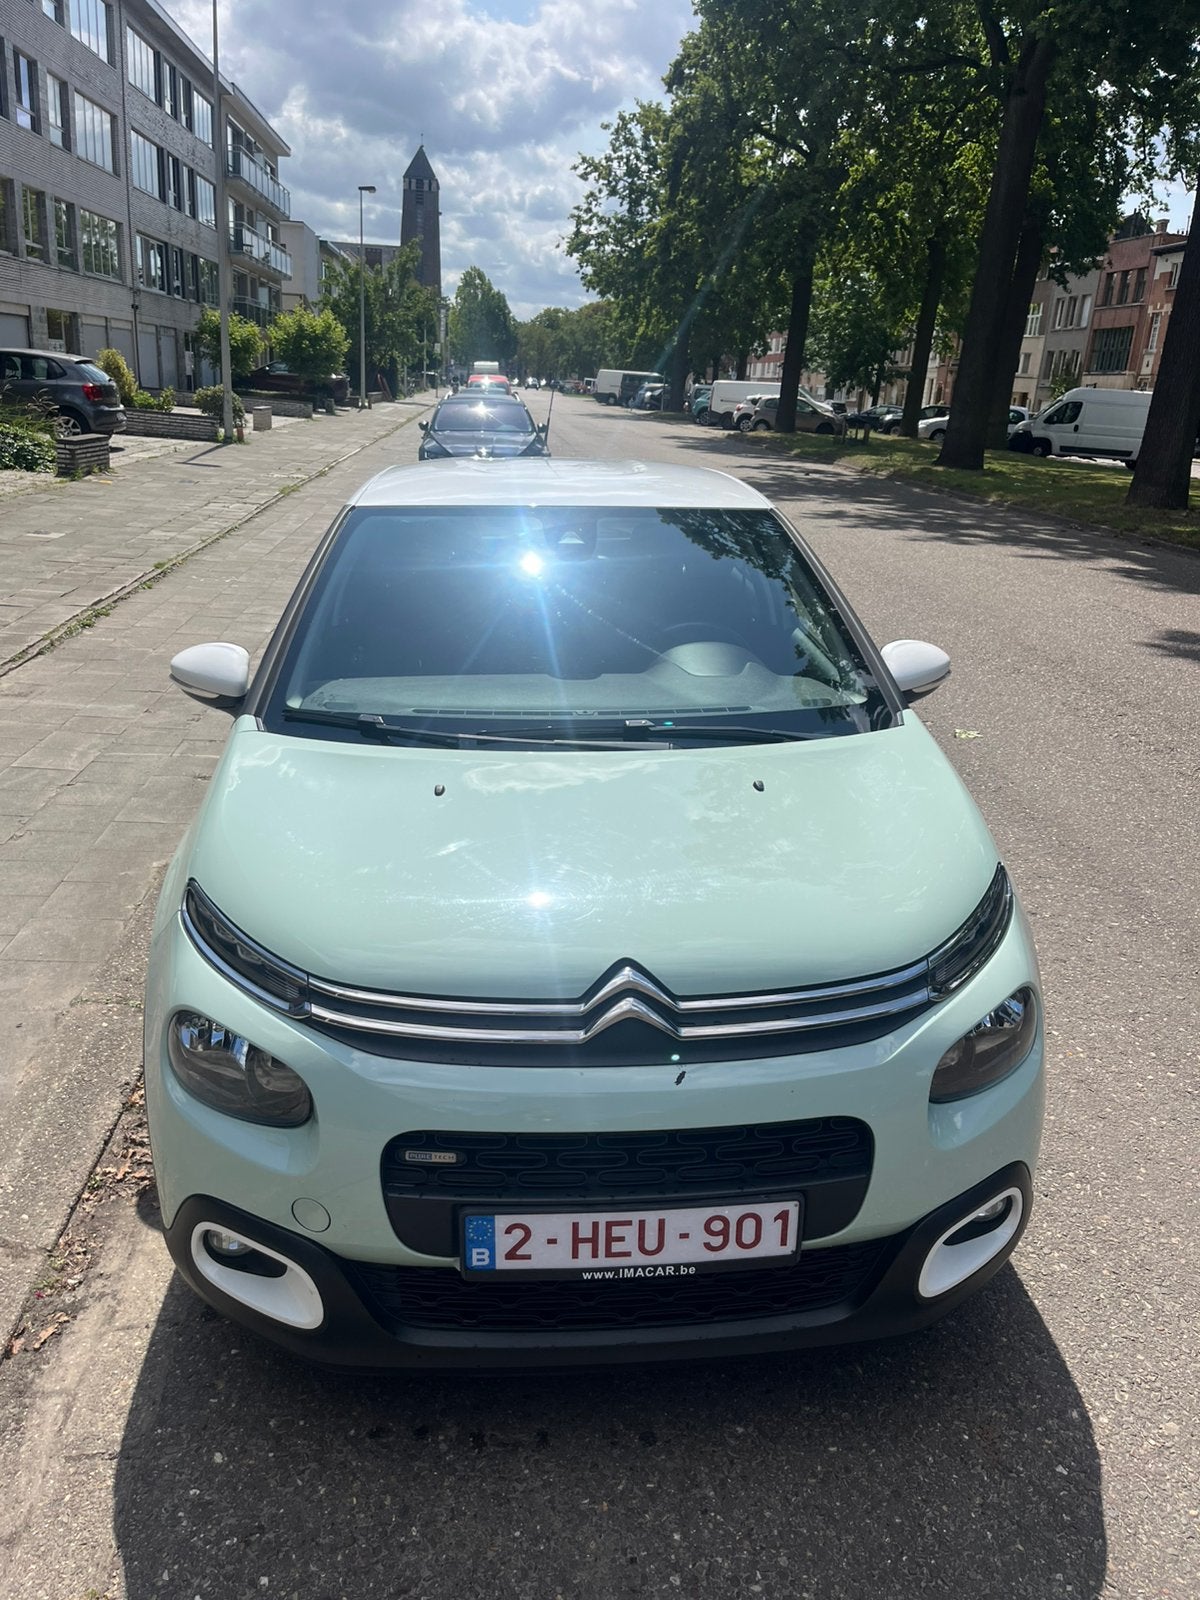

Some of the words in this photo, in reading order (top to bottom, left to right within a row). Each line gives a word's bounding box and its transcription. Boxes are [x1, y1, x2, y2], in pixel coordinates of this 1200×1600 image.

[433, 1153, 455, 1161] TECH
[472, 1247, 490, 1267] B
[582, 1265, 697, 1280] www.IMACAR.be
